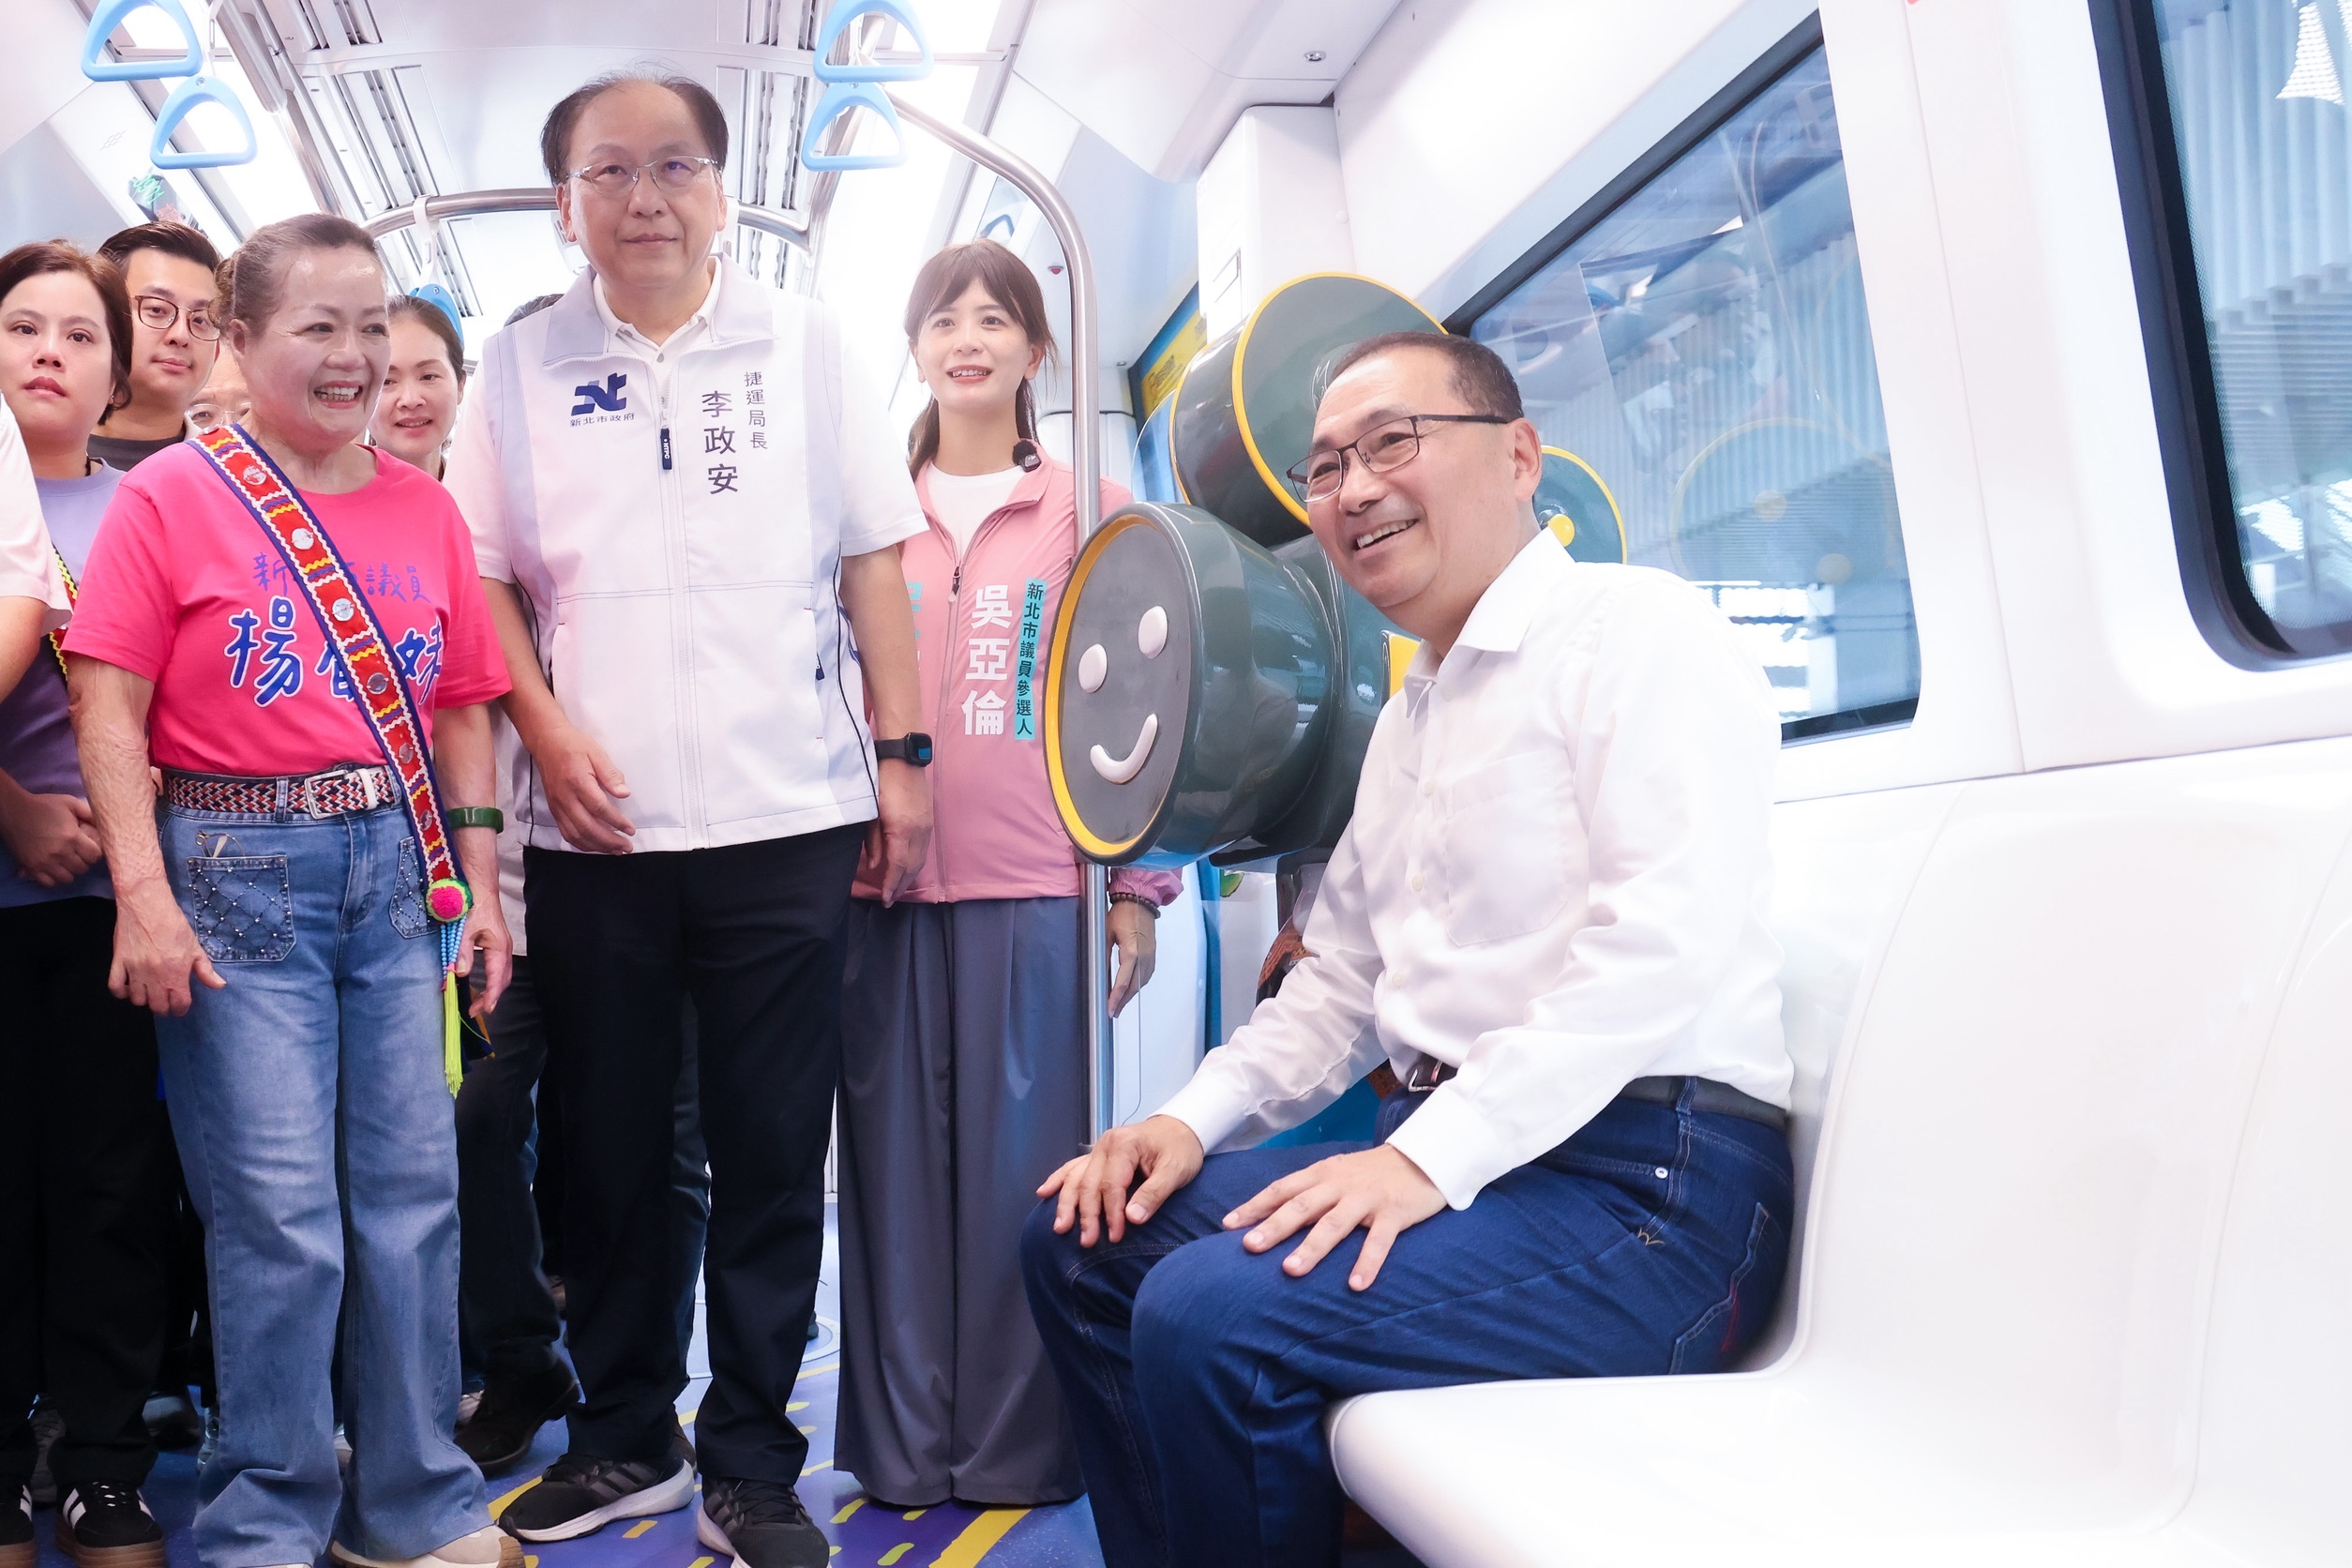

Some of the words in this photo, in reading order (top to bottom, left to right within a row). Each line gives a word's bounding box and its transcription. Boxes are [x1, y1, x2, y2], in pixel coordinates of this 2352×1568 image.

[570, 413, 635, 427] 新北市政府
[701, 390, 738, 494] 李政安
[744, 371, 767, 449] 捷運局長
[253, 552, 430, 603] 新議員
[961, 584, 1012, 735] 吳亞倫
[1016, 582, 1043, 735] 新北市議員參選人
